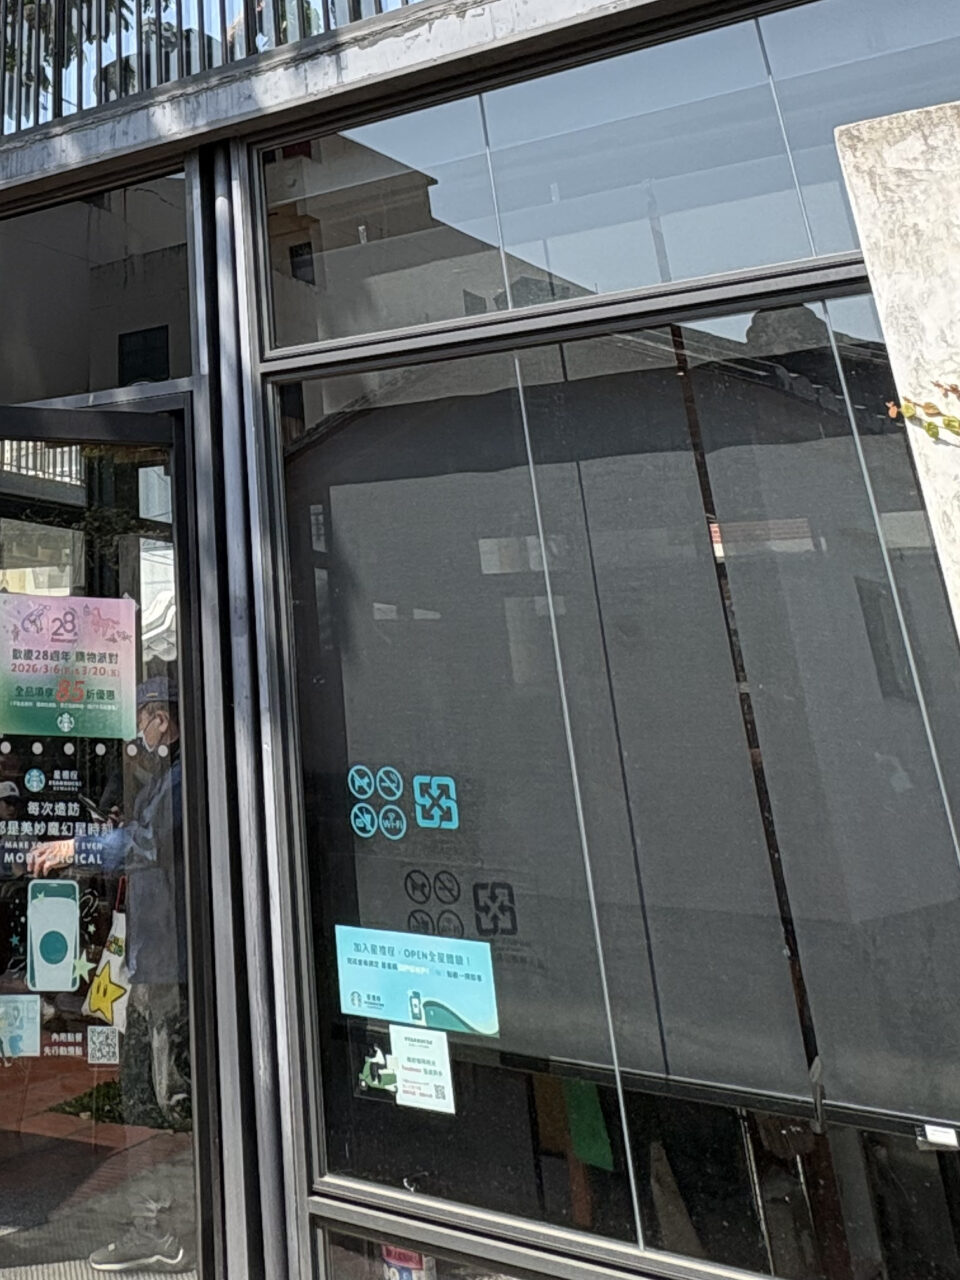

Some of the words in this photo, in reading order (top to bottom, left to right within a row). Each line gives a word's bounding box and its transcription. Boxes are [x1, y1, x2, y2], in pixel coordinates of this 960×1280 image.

[51, 610, 76, 637] 28
[27, 801, 80, 816] 每次造訪
[4, 841, 29, 850] MAKE
